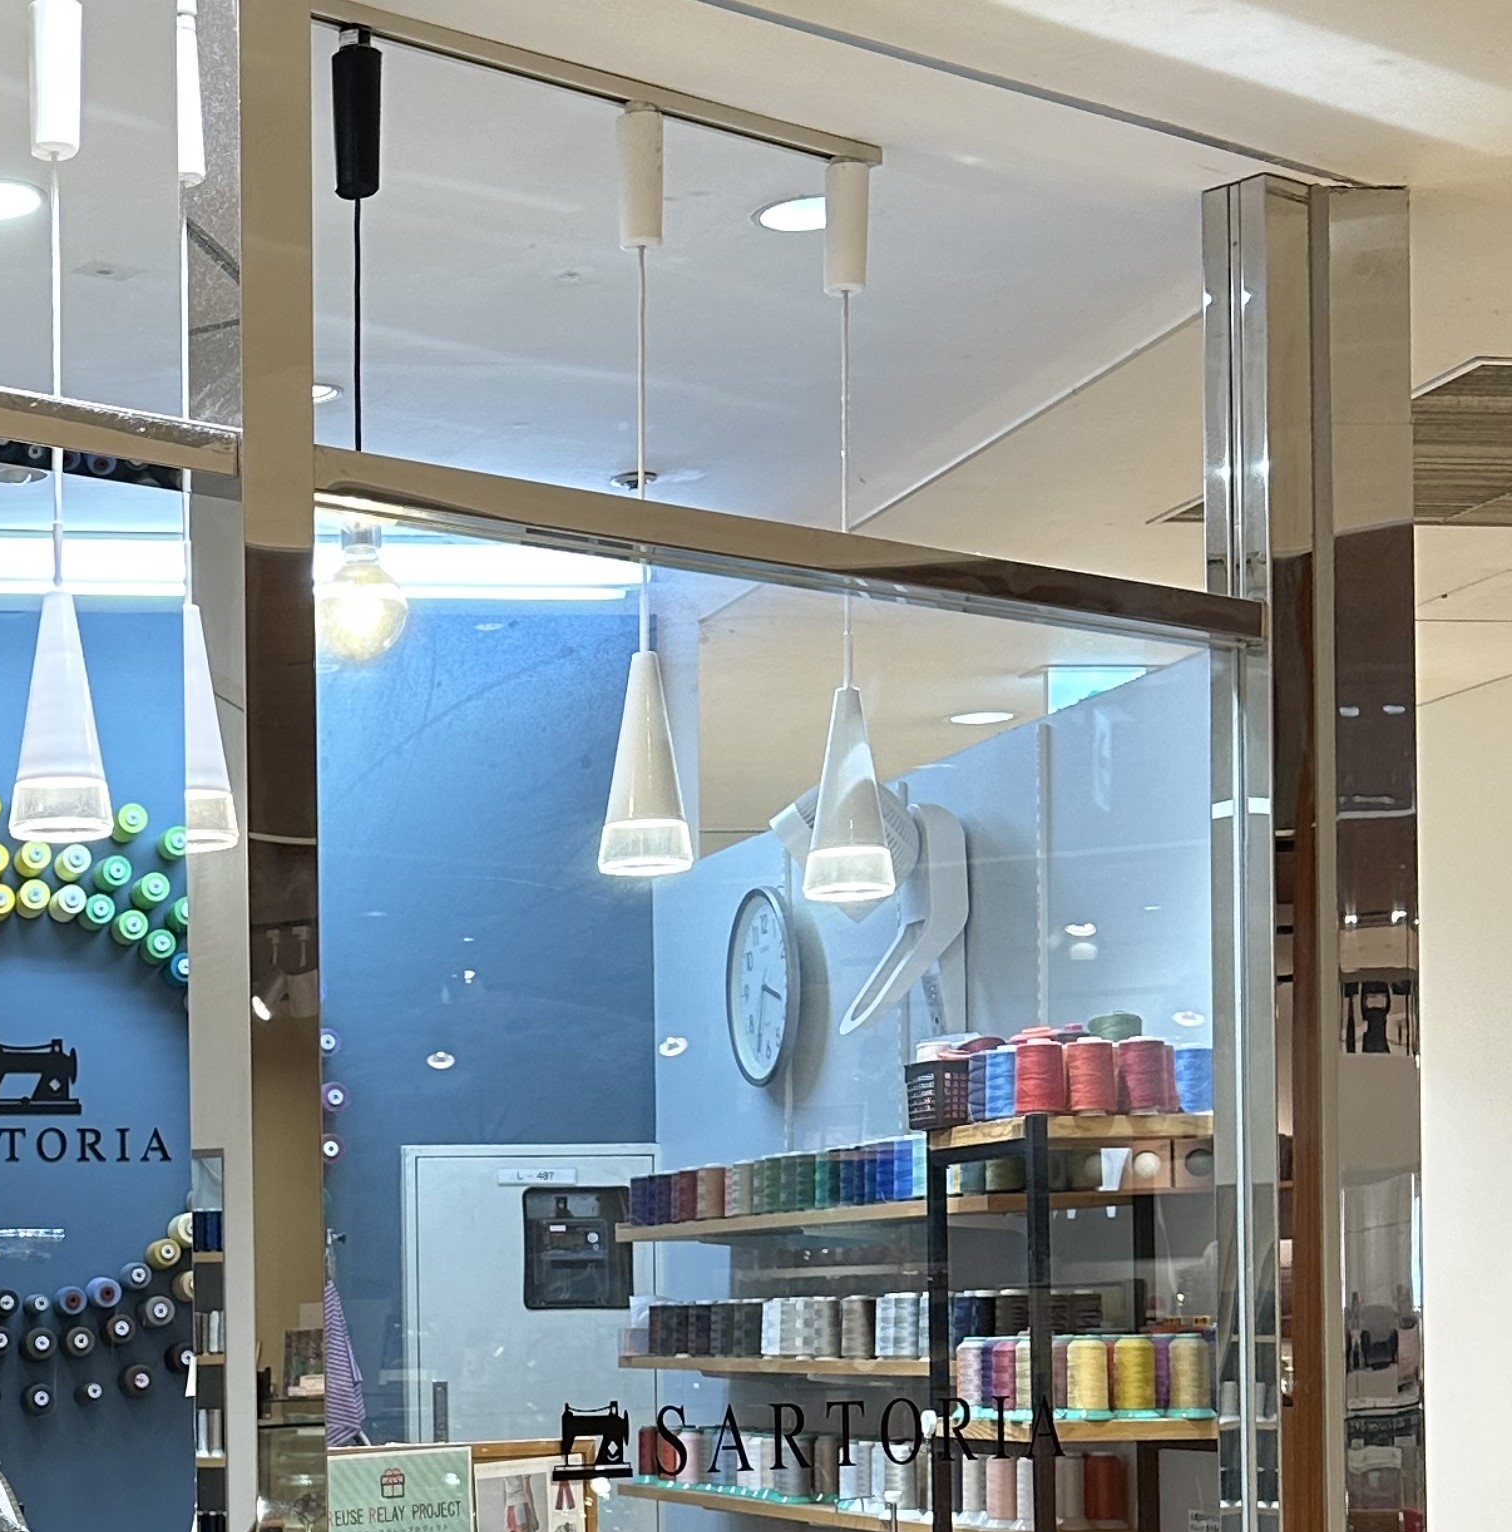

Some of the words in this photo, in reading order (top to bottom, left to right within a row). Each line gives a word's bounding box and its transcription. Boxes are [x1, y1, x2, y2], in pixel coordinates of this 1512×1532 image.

[656, 1395, 1067, 1476] SARTORIA
[369, 1505, 405, 1524] RELAY
[411, 1501, 461, 1519] PROJECT
